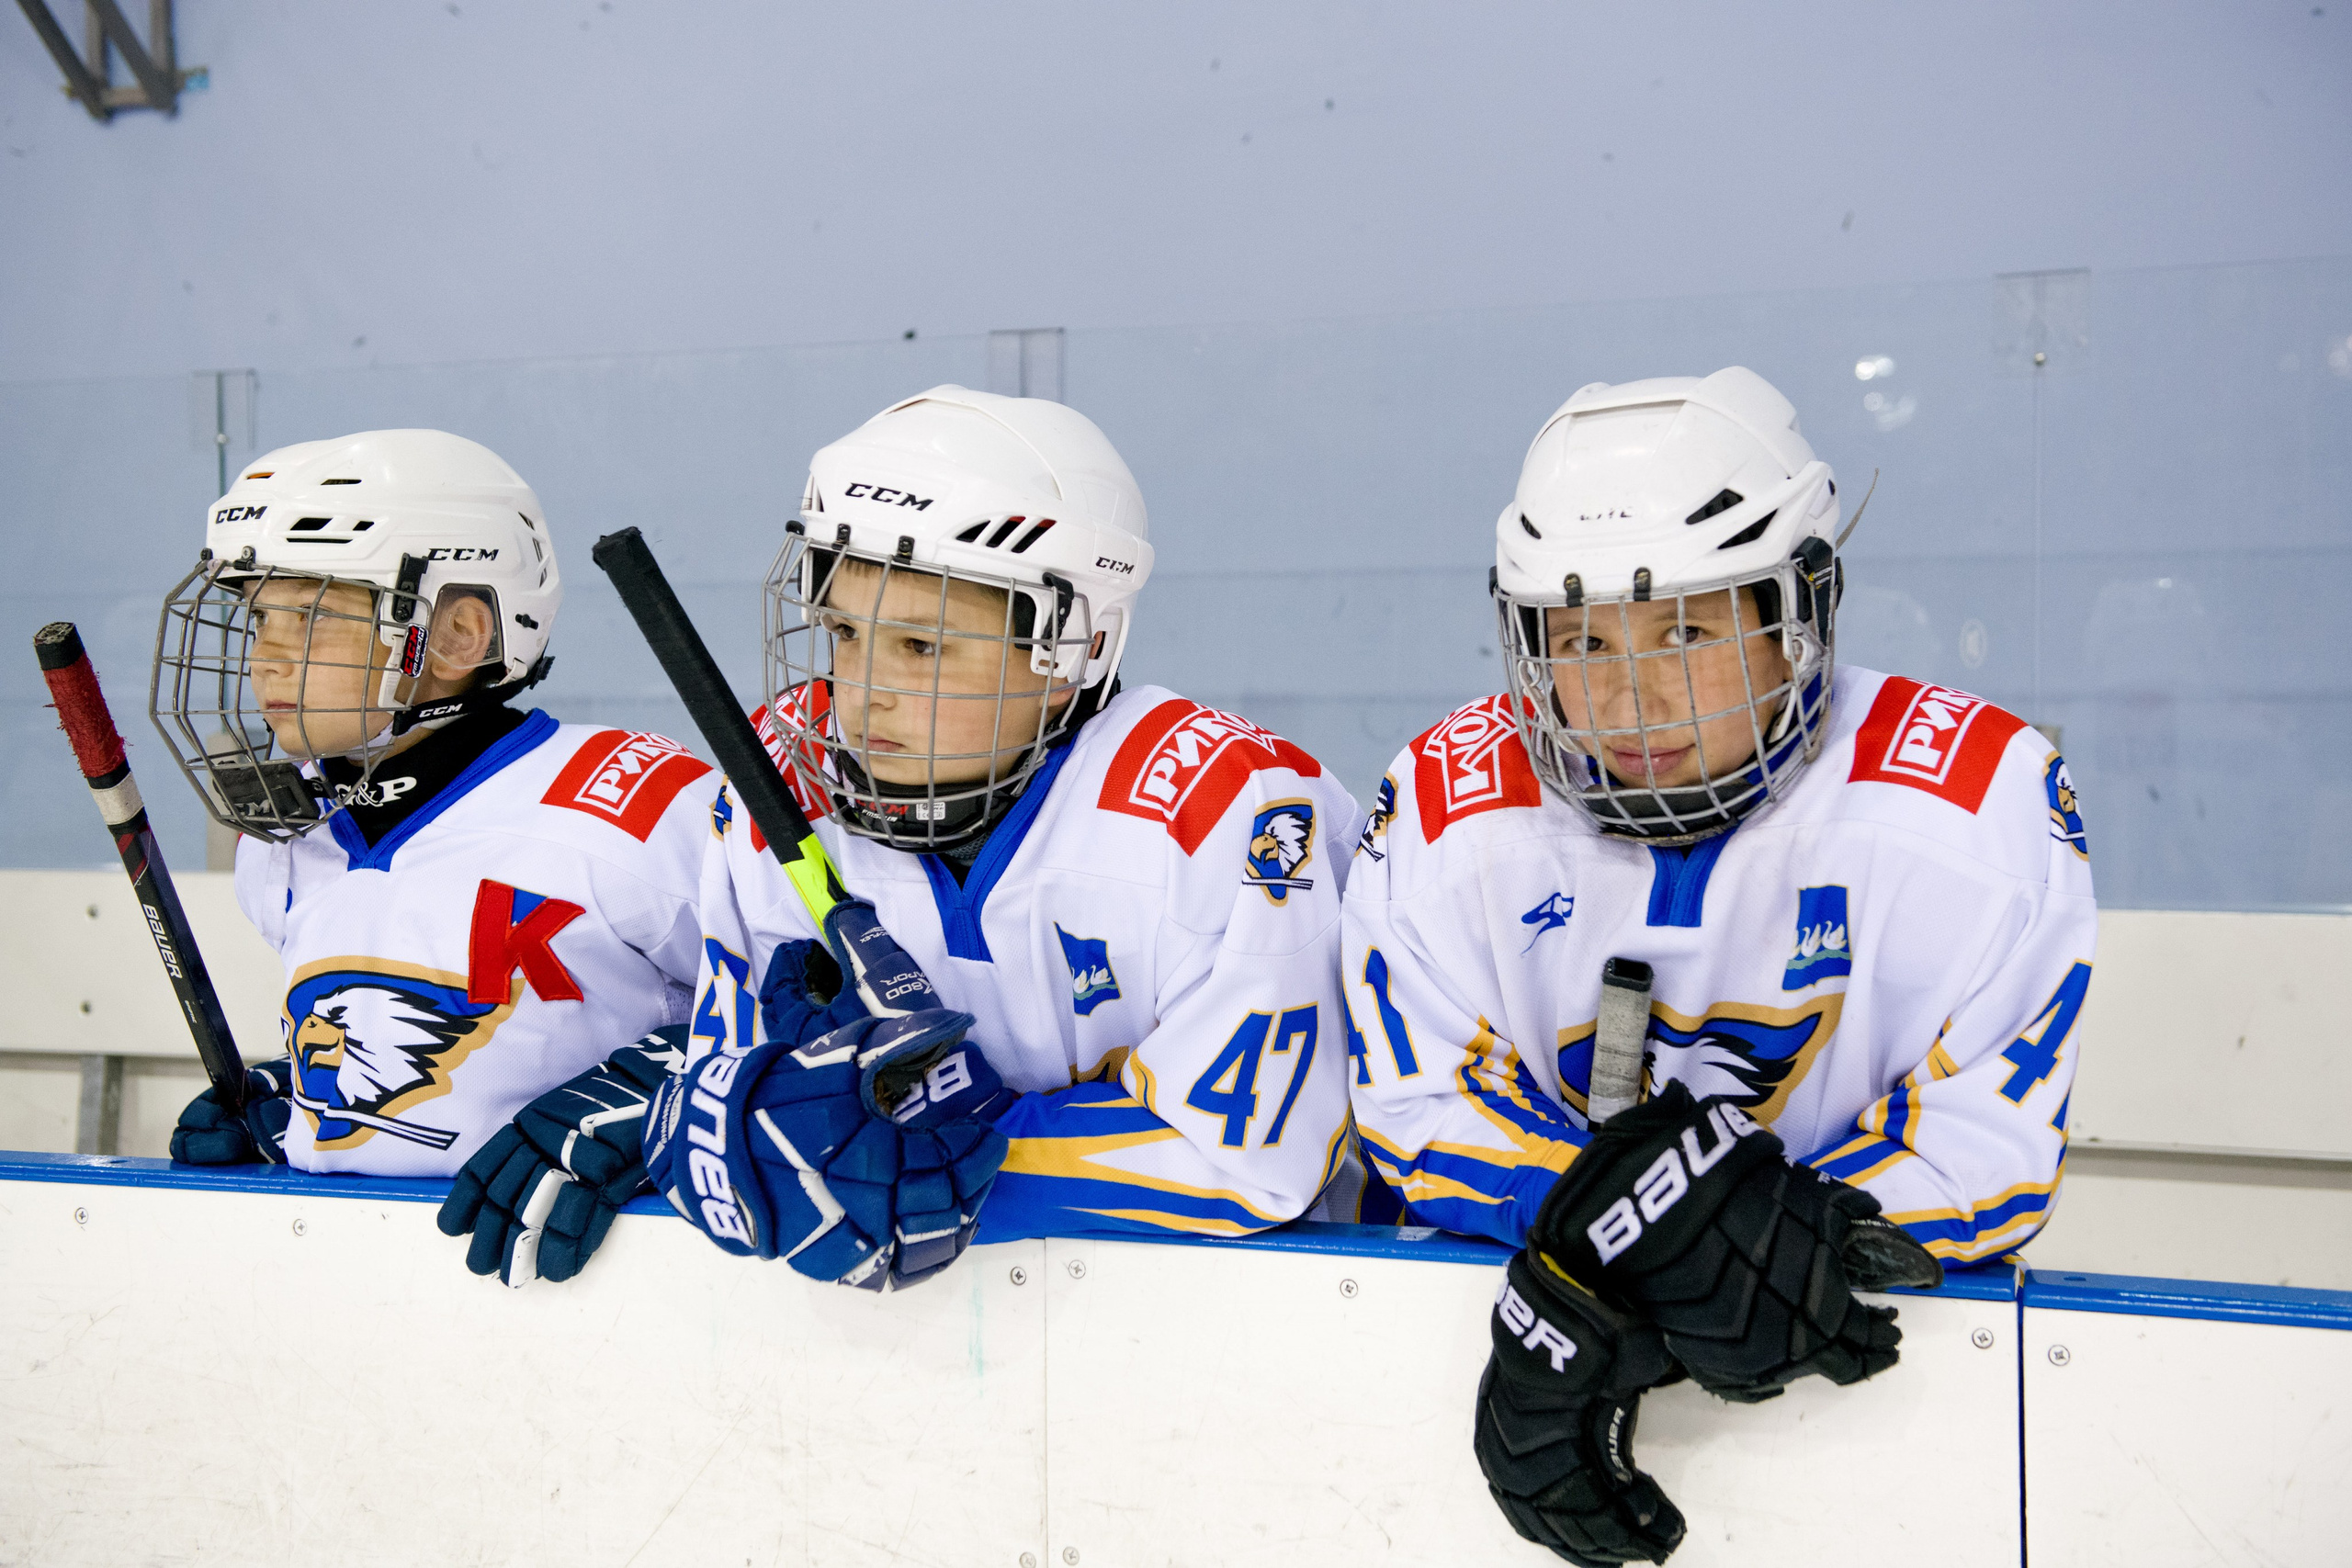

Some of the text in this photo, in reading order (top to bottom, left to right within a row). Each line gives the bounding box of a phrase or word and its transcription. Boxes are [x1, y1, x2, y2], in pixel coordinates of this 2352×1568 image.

[215, 505, 268, 525] CCM
[844, 482, 934, 512] CCM
[428, 547, 500, 561] CCM
[1095, 556, 1135, 575] CCM
[404, 626, 419, 674] CCM
[419, 703, 463, 718] CCM
[142, 903, 183, 979] BAUER
[1182, 1001, 1318, 1151] 47
[688, 1045, 757, 1249] BAUE
[1587, 1102, 1763, 1267] BAUE
